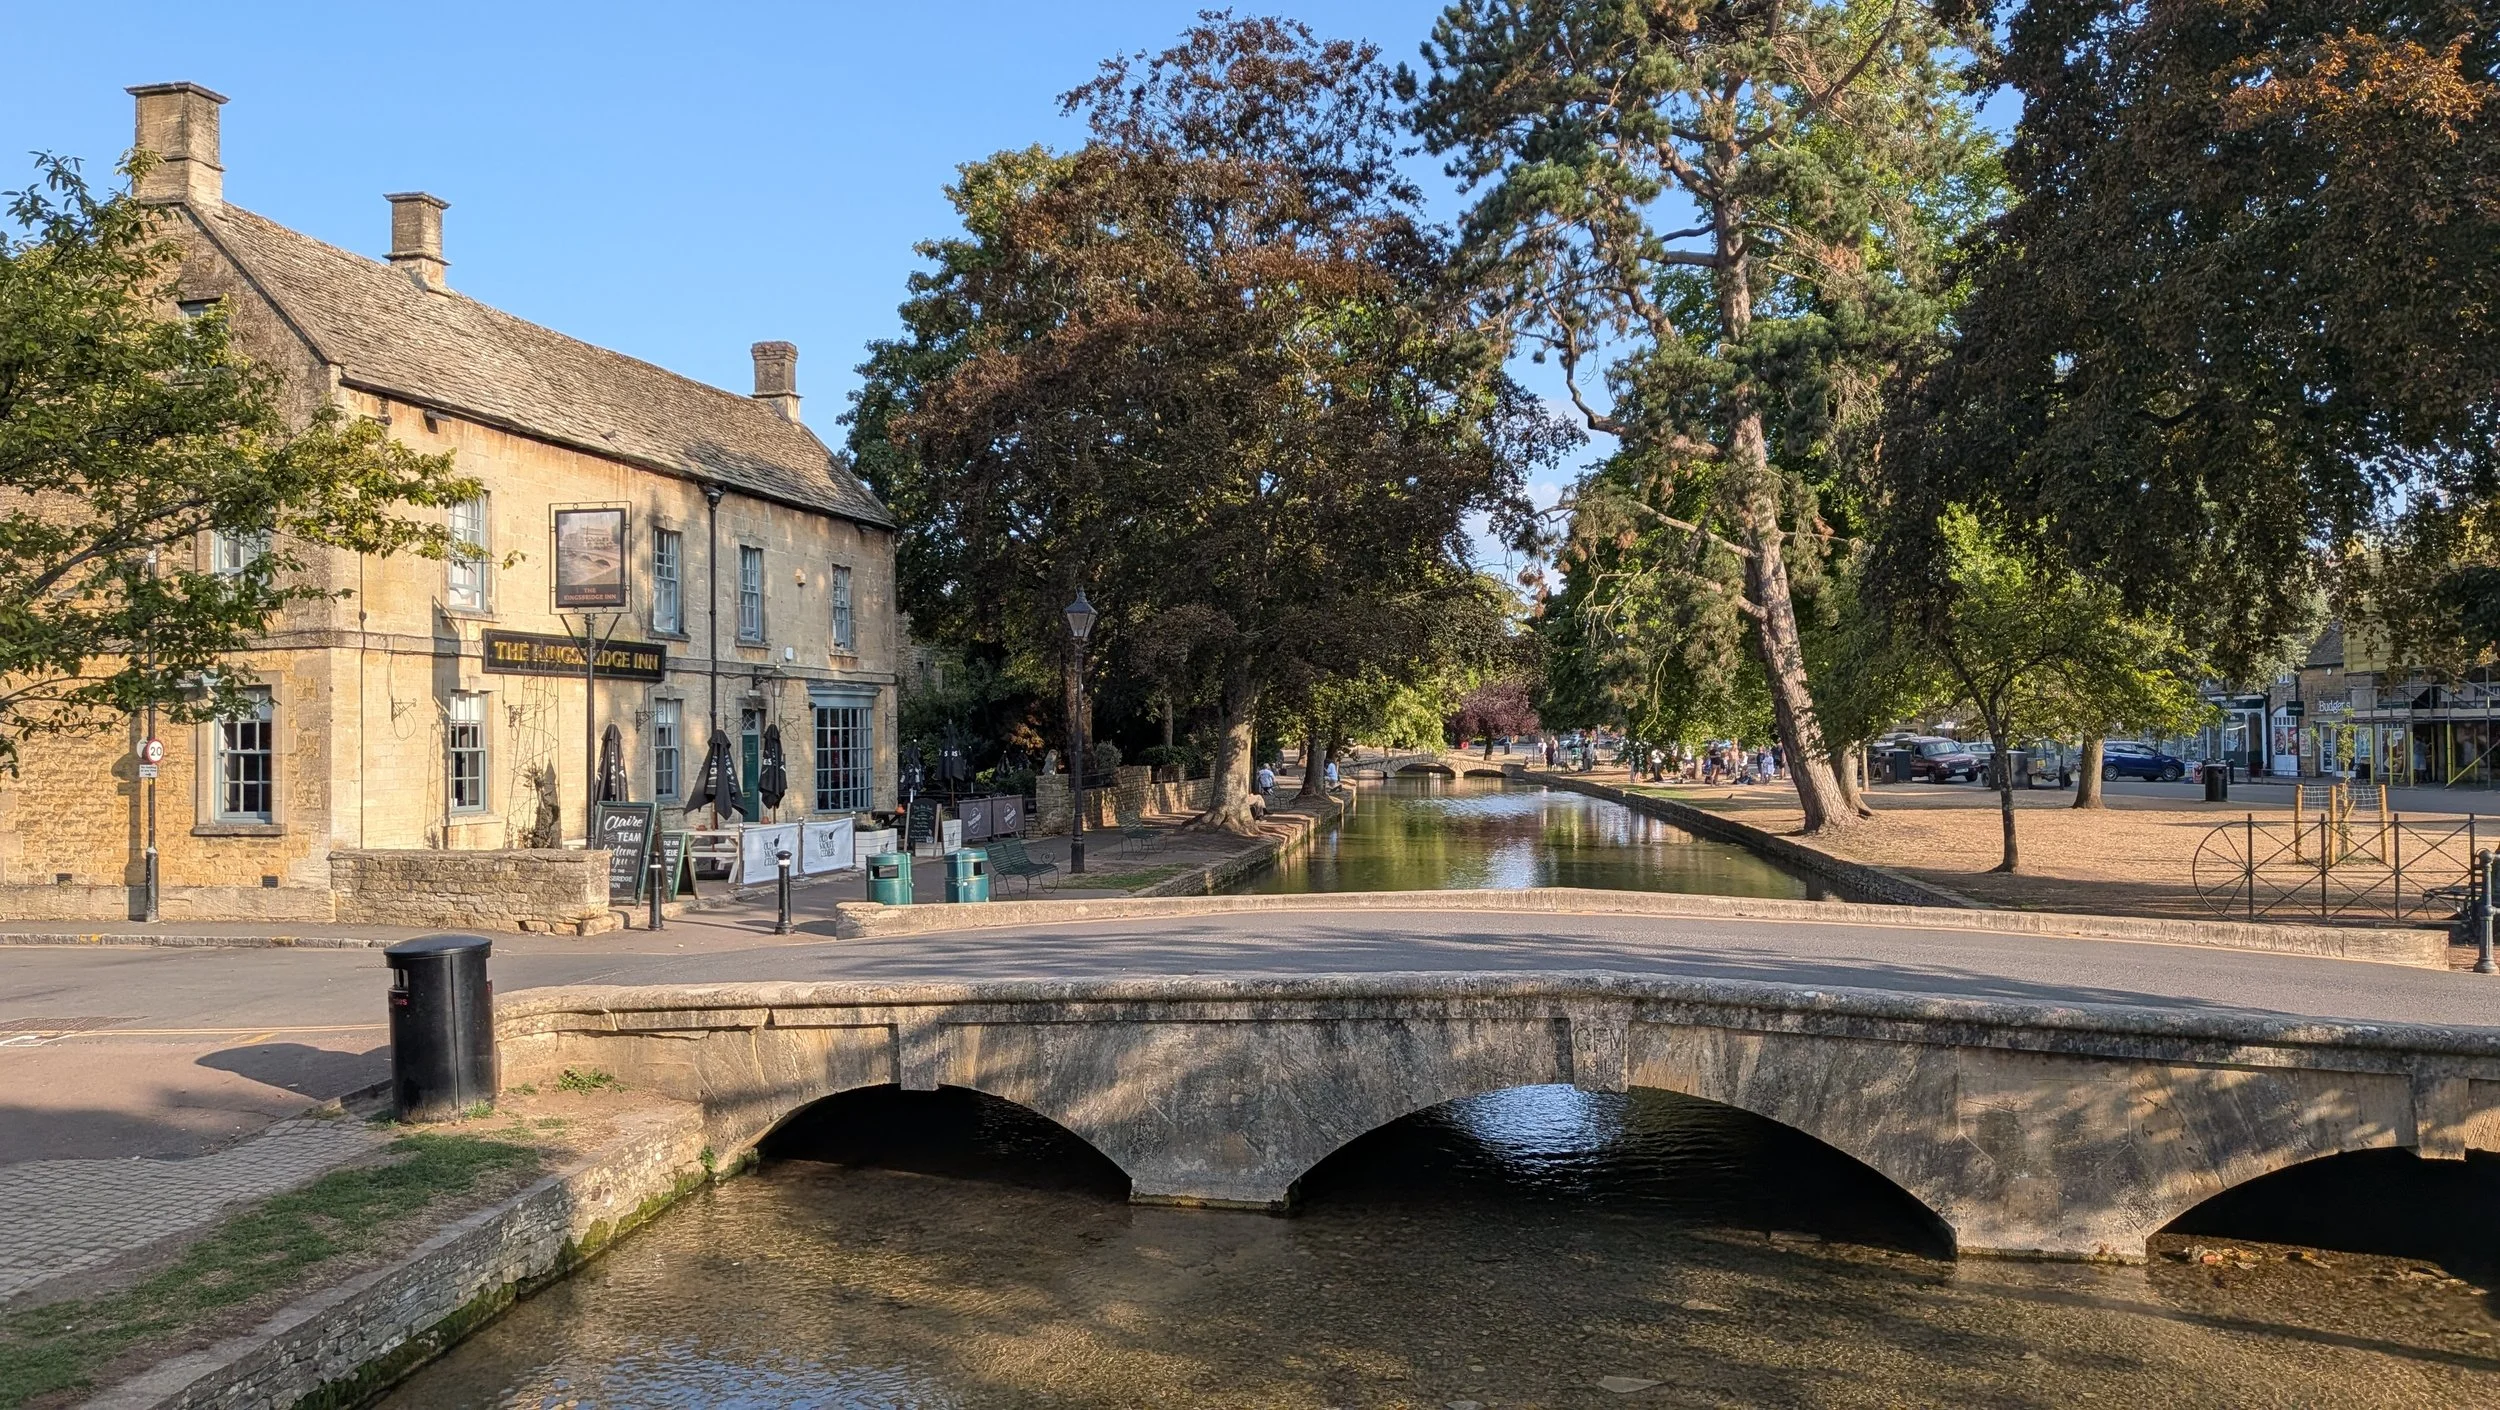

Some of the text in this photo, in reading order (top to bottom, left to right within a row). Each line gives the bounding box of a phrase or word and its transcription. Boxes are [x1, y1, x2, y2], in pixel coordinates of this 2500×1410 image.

[494, 641, 659, 670] THE KINGSBIDGE INN
[150, 746, 162, 756] 20
[605, 815, 643, 831] Claire
[617, 832, 641, 842] TEAM
